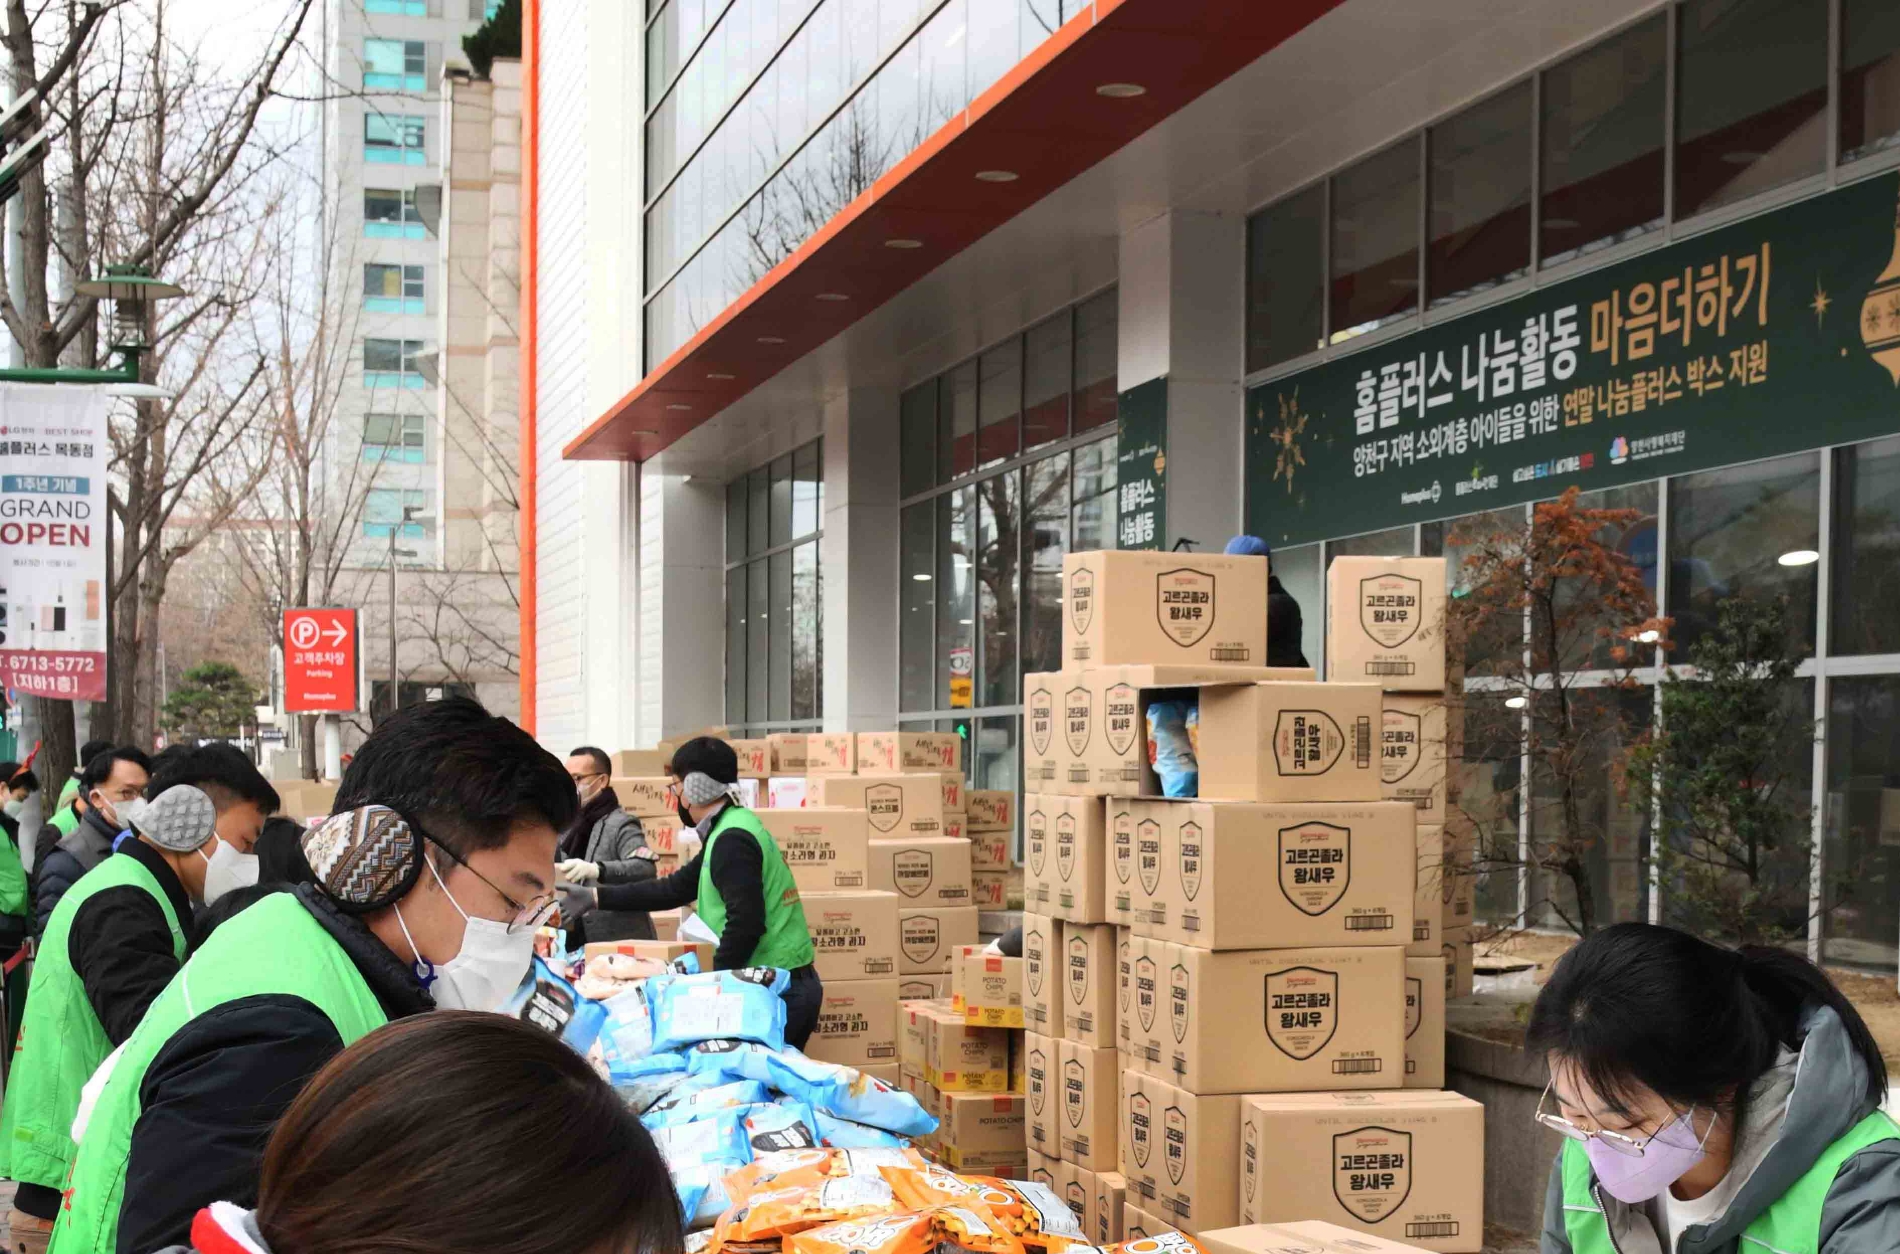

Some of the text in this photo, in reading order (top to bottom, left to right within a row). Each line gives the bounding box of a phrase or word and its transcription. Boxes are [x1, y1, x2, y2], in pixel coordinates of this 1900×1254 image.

[1353, 241, 1770, 436] 홈플러스 나눔활동 마음더하기
[1353, 339, 1767, 477] 양천구 지역 소외계층 아이들을 위한 연말 나눔플러스 박스 지원
[55, 443, 94, 458] 목동점
[16, 477, 77, 493] 1주년 기념
[1120, 478, 1155, 514] 홈플러스
[1, 499, 91, 519] GRAND
[0, 522, 90, 547] OPEN
[1120, 511, 1155, 546] 나눔활동
[1163, 591, 1209, 604] 고르곤졸라
[1366, 595, 1415, 607] 고르곤졸라
[1170, 606, 1203, 620] 왕새우
[1374, 610, 1408, 623] 왕새우
[294, 652, 345, 666] 고객주차장
[306, 669, 333, 679] Parking
[1294, 716, 1305, 769] 고르곤졸라
[1308, 724, 1320, 761] 왕새우
[1382, 746, 1407, 758] 새우
[1285, 849, 1343, 864] 고르곤졸라
[1294, 867, 1335, 884] 왕새우
[982, 977, 1007, 985] POTATO
[985, 983, 1004, 991] CHIPS
[1272, 993, 1330, 1009] 고르곤졸라
[1281, 1012, 1322, 1028] 왕새우
[964, 1048, 985, 1056] CHIPS
[979, 1117, 1006, 1125] POTATO
[1340, 1154, 1404, 1170] 고르곤졸라
[1350, 1173, 1395, 1190] 왕새우
